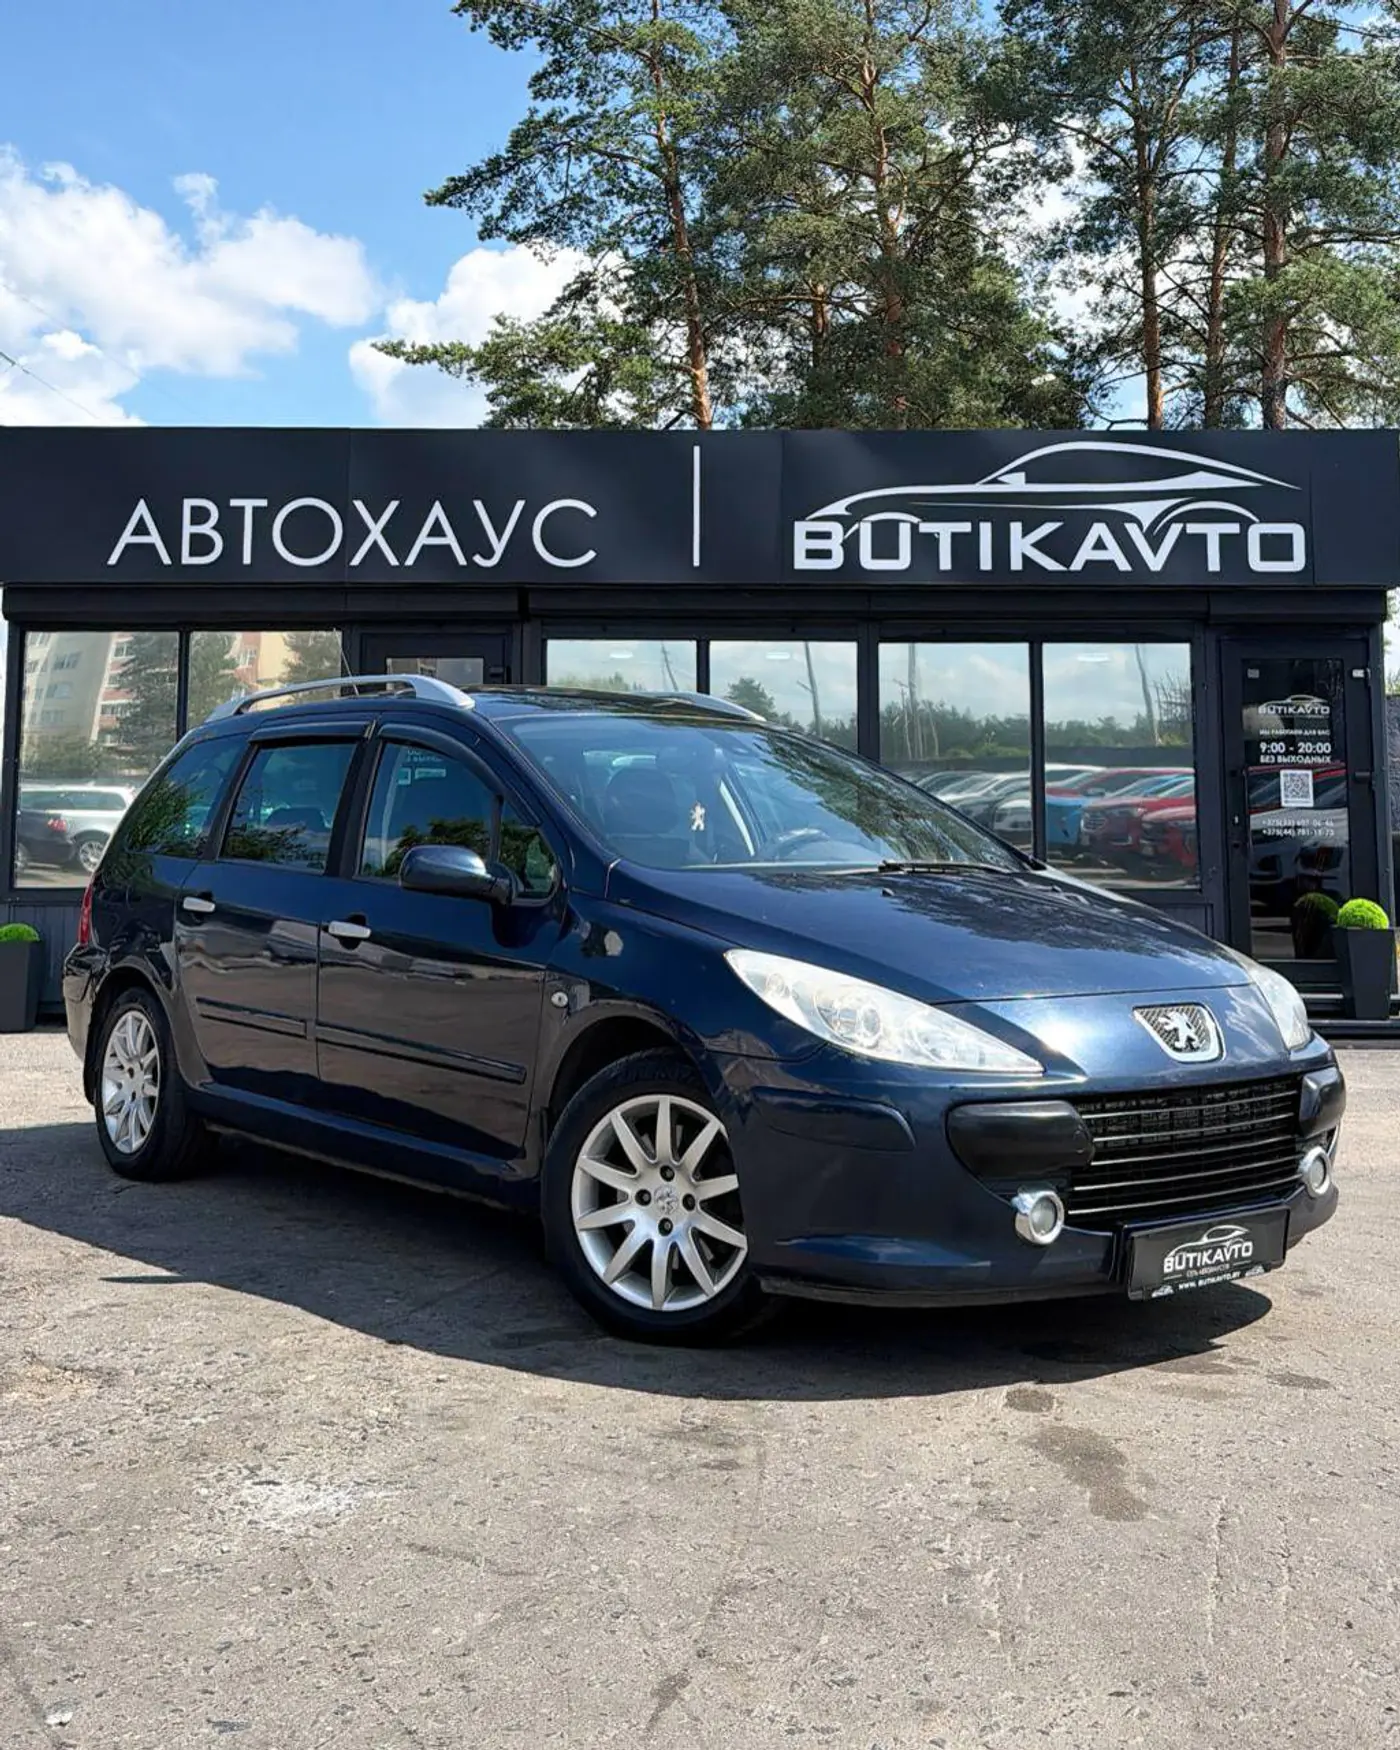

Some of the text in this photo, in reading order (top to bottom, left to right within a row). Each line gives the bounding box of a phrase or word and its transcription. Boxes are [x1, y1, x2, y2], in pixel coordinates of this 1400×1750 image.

[107, 497, 598, 568] АВТОХАУС
[793, 520, 1306, 572] BUTIKAVTO
[1258, 705, 1331, 715] BUTIKAVTO
[1260, 742, 1286, 754] 9:00
[1297, 742, 1332, 754] 20:00
[1260, 755, 1332, 764] БЕЗ ВЫХОДНЫХ
[1163, 1241, 1253, 1274] BUTIKAVTO
